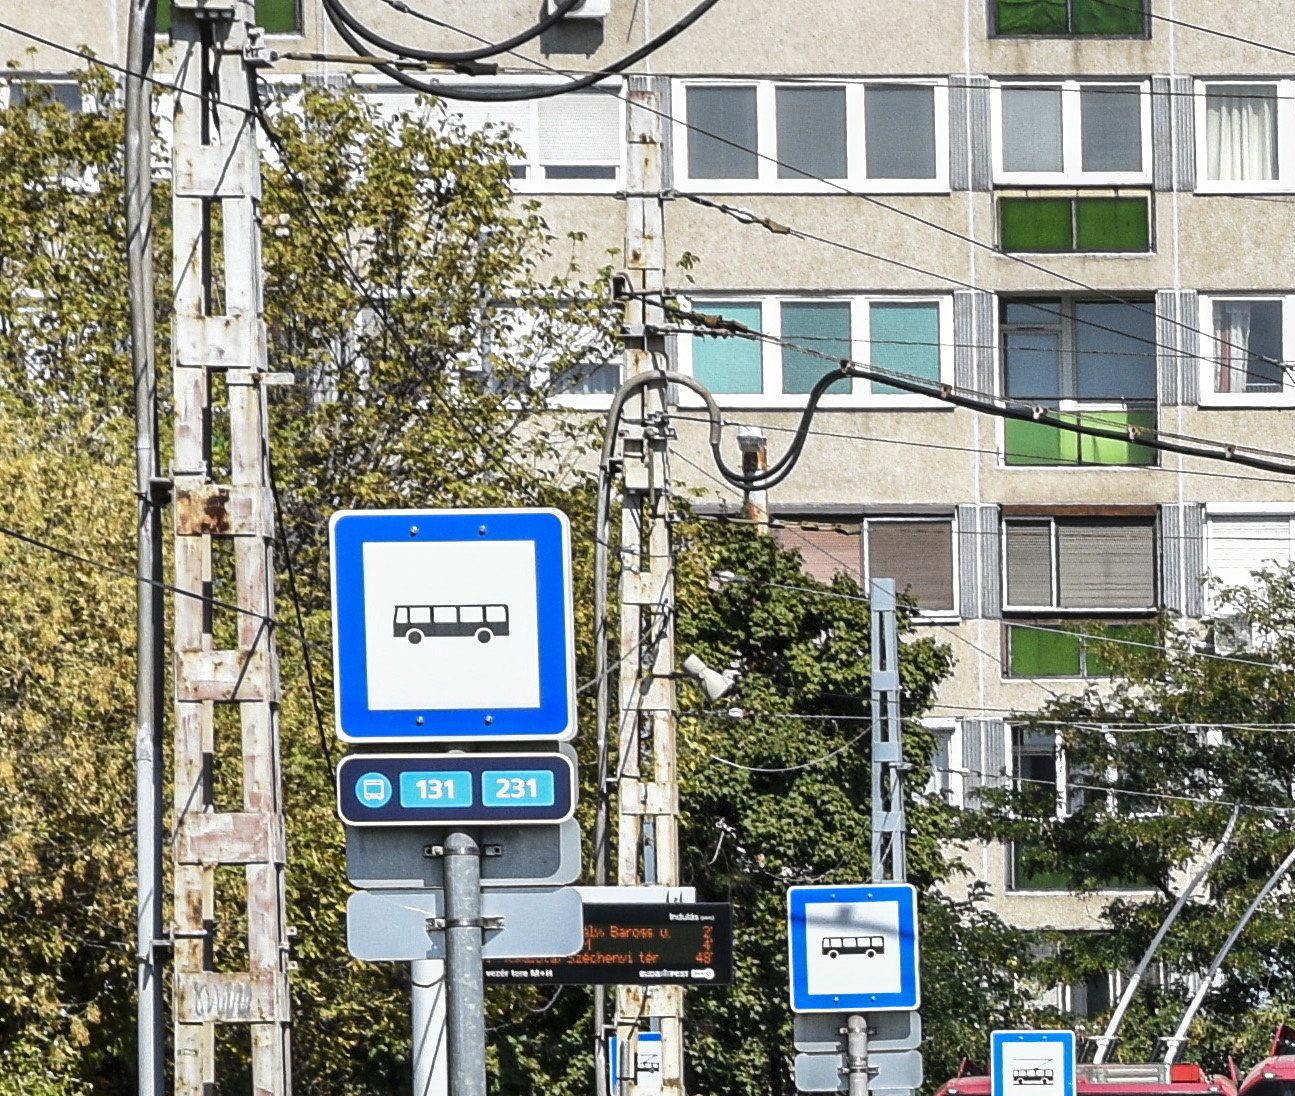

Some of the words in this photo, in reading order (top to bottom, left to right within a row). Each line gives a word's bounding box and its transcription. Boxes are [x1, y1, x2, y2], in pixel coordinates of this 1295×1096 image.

[416, 779, 455, 800] 131
[496, 778, 538, 799] 231
[610, 926, 654, 939] Baross
